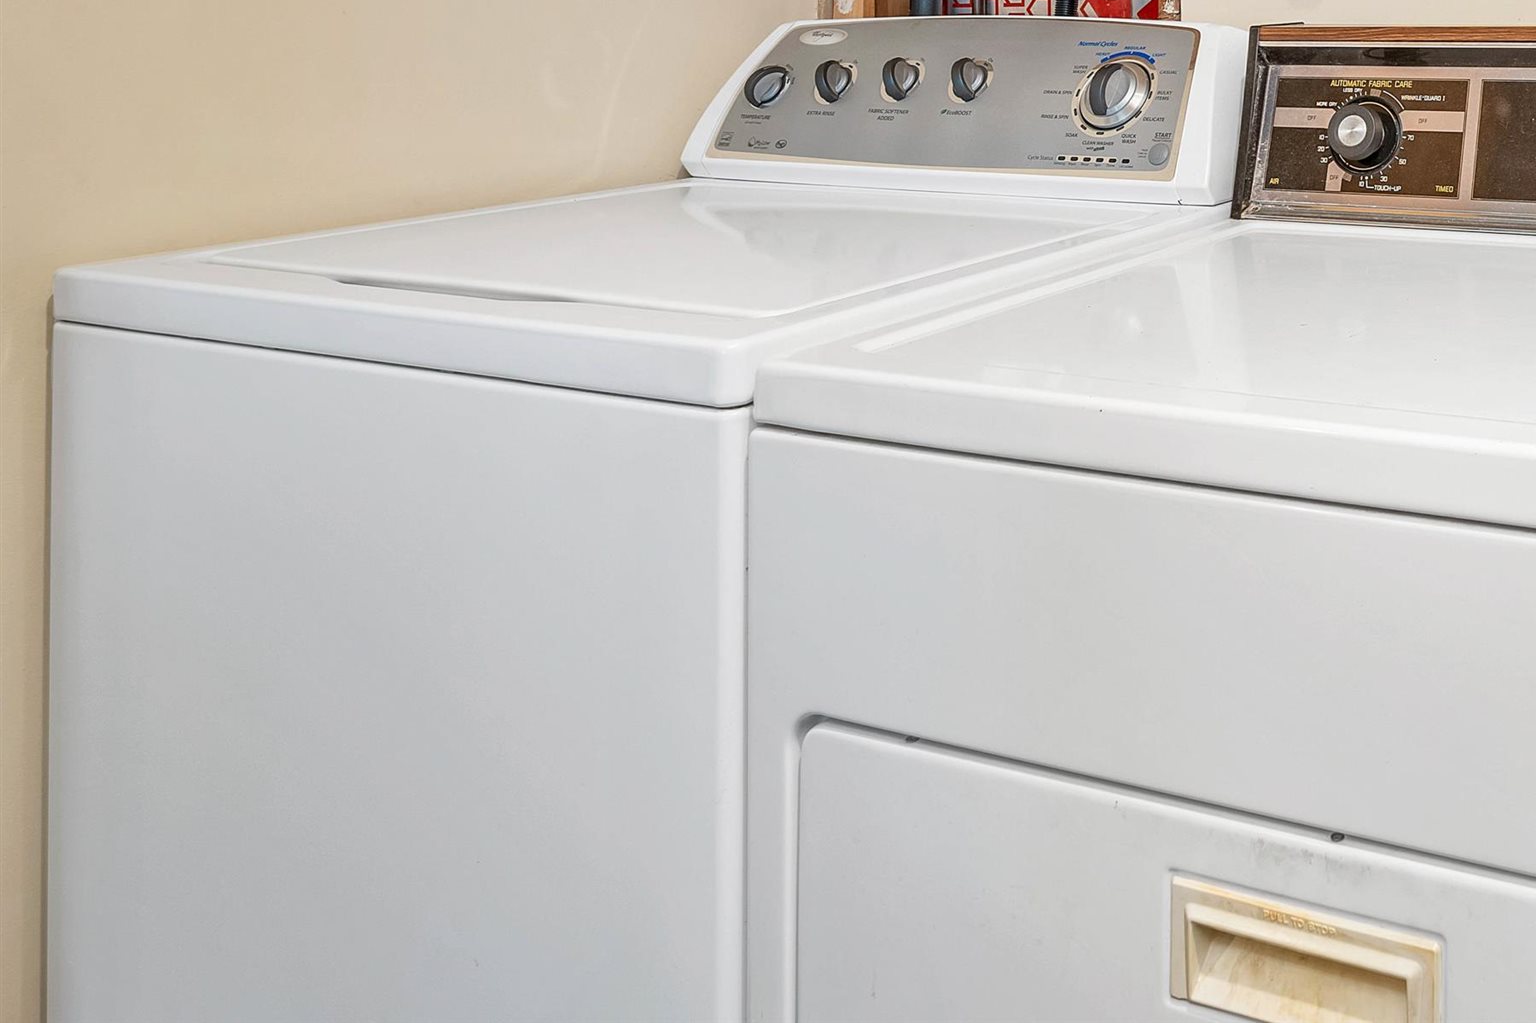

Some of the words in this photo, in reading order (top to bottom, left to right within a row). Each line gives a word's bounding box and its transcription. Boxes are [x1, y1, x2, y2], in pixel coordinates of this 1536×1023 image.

[1330, 79, 1368, 88] AUTOMATIC
[1368, 80, 1392, 88] FABRIC
[1394, 80, 1414, 88] CARE
[1269, 177, 1280, 186] AIR
[1374, 184, 1402, 192] TOUCH-UP
[1435, 185, 1454, 193] TIMED
[1263, 909, 1290, 924] PULL
[1291, 915, 1306, 928] TO
[1307, 918, 1336, 937] STOP
